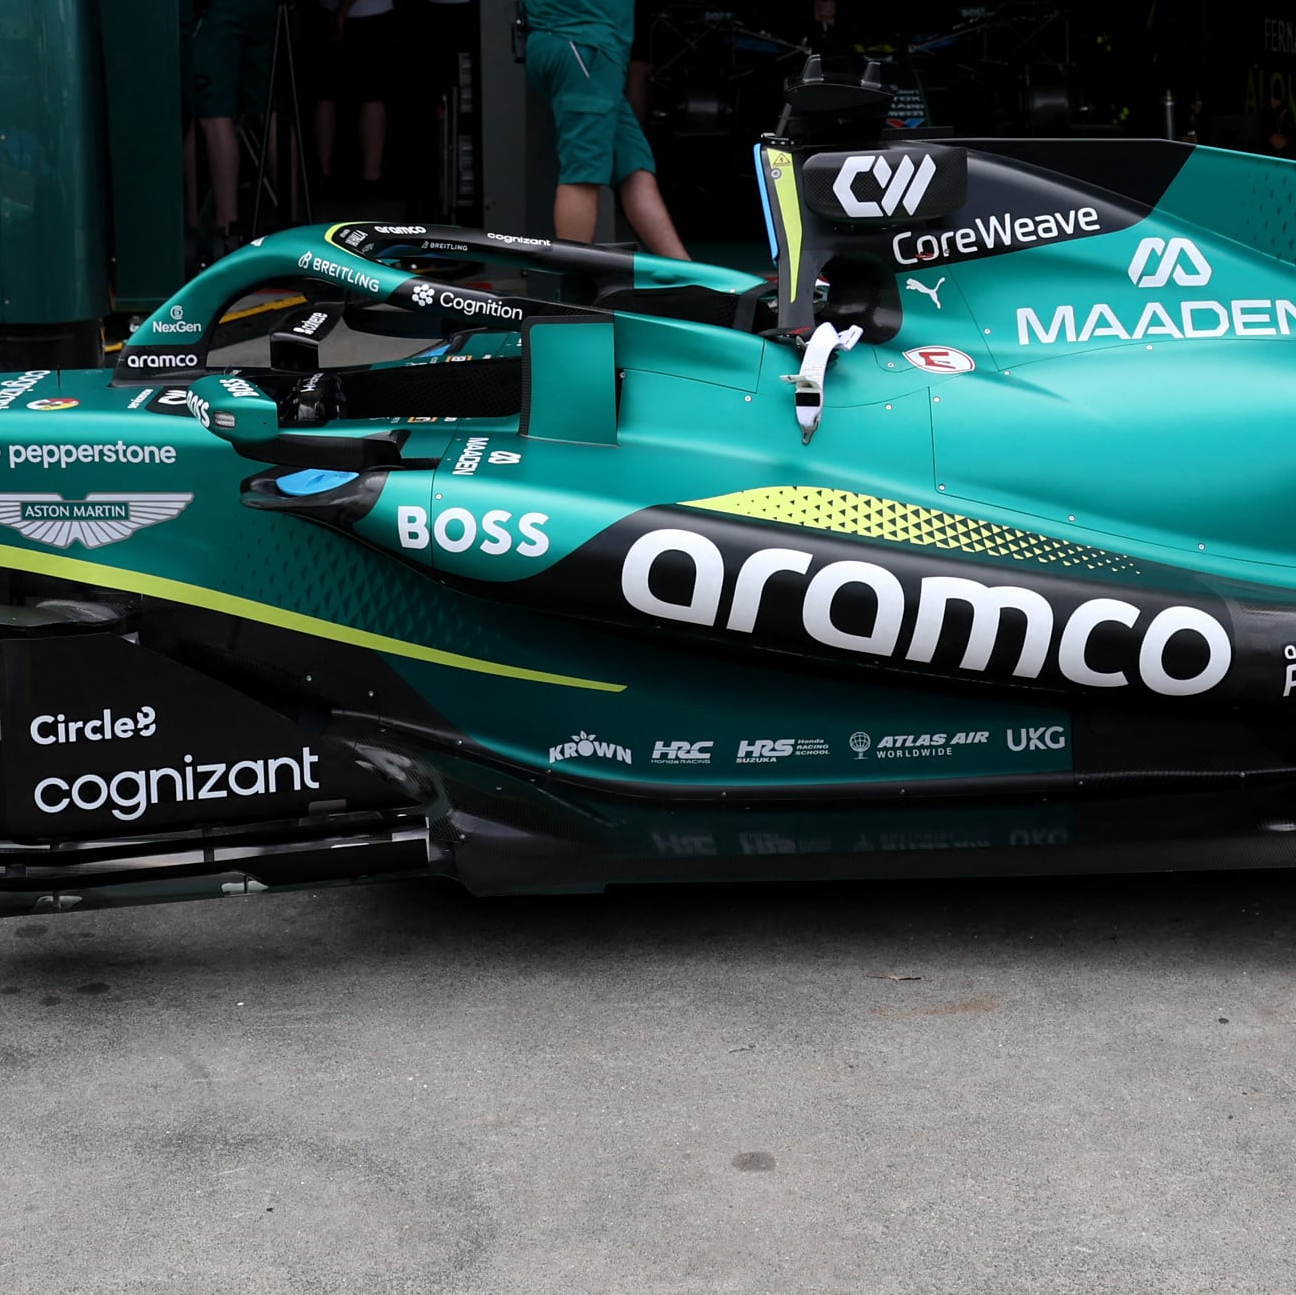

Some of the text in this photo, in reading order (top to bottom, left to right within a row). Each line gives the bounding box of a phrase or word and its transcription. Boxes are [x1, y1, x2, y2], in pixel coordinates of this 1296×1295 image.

[374, 225, 427, 235] aramco
[487, 232, 551, 247] cognizant
[891, 202, 1101, 270] CoreWeave
[429, 242, 468, 251] BREITLING
[312, 257, 380, 293] BREITLING
[440, 291, 523, 321] Cognition
[152, 321, 202, 333] NexGen
[127, 354, 198, 368] aramco
[8, 439, 177, 469] pepperstone
[452, 437, 490, 475] MAADEN
[25, 503, 127, 519] ASTON MARTIN
[397, 505, 550, 557] BOSS
[622, 527, 1233, 699] aramco
[652, 740, 714, 758] HRC
[737, 739, 796, 758] HRS
[877, 731, 990, 748] ATLAS AIR
[1006, 726, 1065, 752] UKG
[549, 737, 633, 765] KROWN
[876, 747, 953, 759] WORLDWIDE
[34, 747, 321, 821] cognizant
